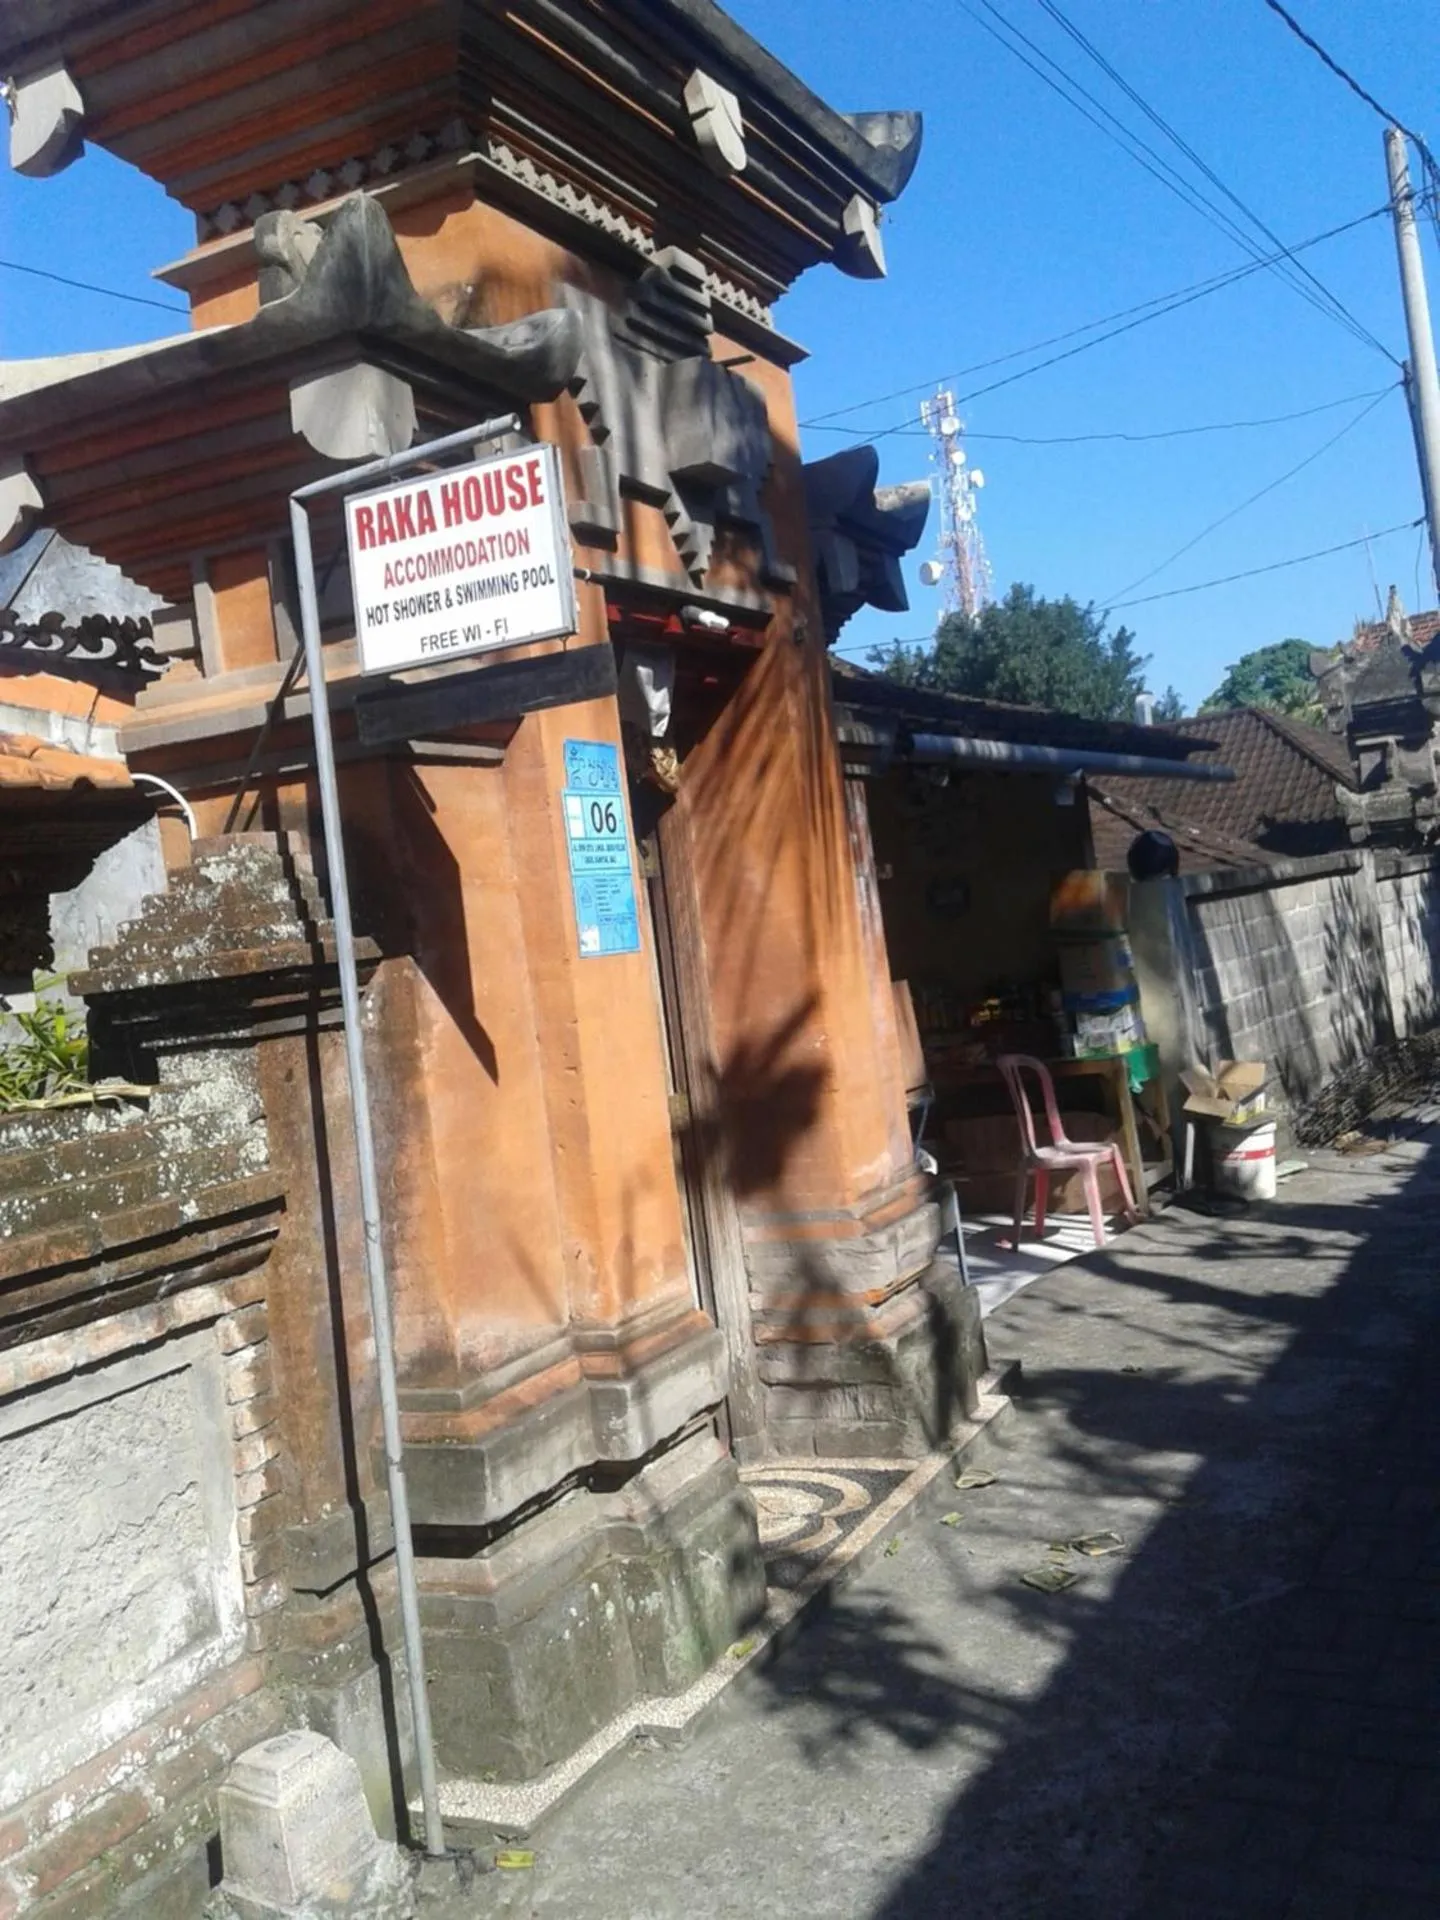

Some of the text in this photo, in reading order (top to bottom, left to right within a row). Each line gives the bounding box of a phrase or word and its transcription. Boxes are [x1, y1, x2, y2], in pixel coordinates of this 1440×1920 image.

[355, 459, 545, 551] RAKA HOUSE
[384, 528, 530, 589] ACCOMMODATION
[366, 563, 555, 627] HOT SHOWER & SWIMMING POOL
[420, 629, 459, 653] FREE
[462, 624, 482, 644] WI
[495, 617, 509, 636] FI
[590, 801, 617, 834] 06
